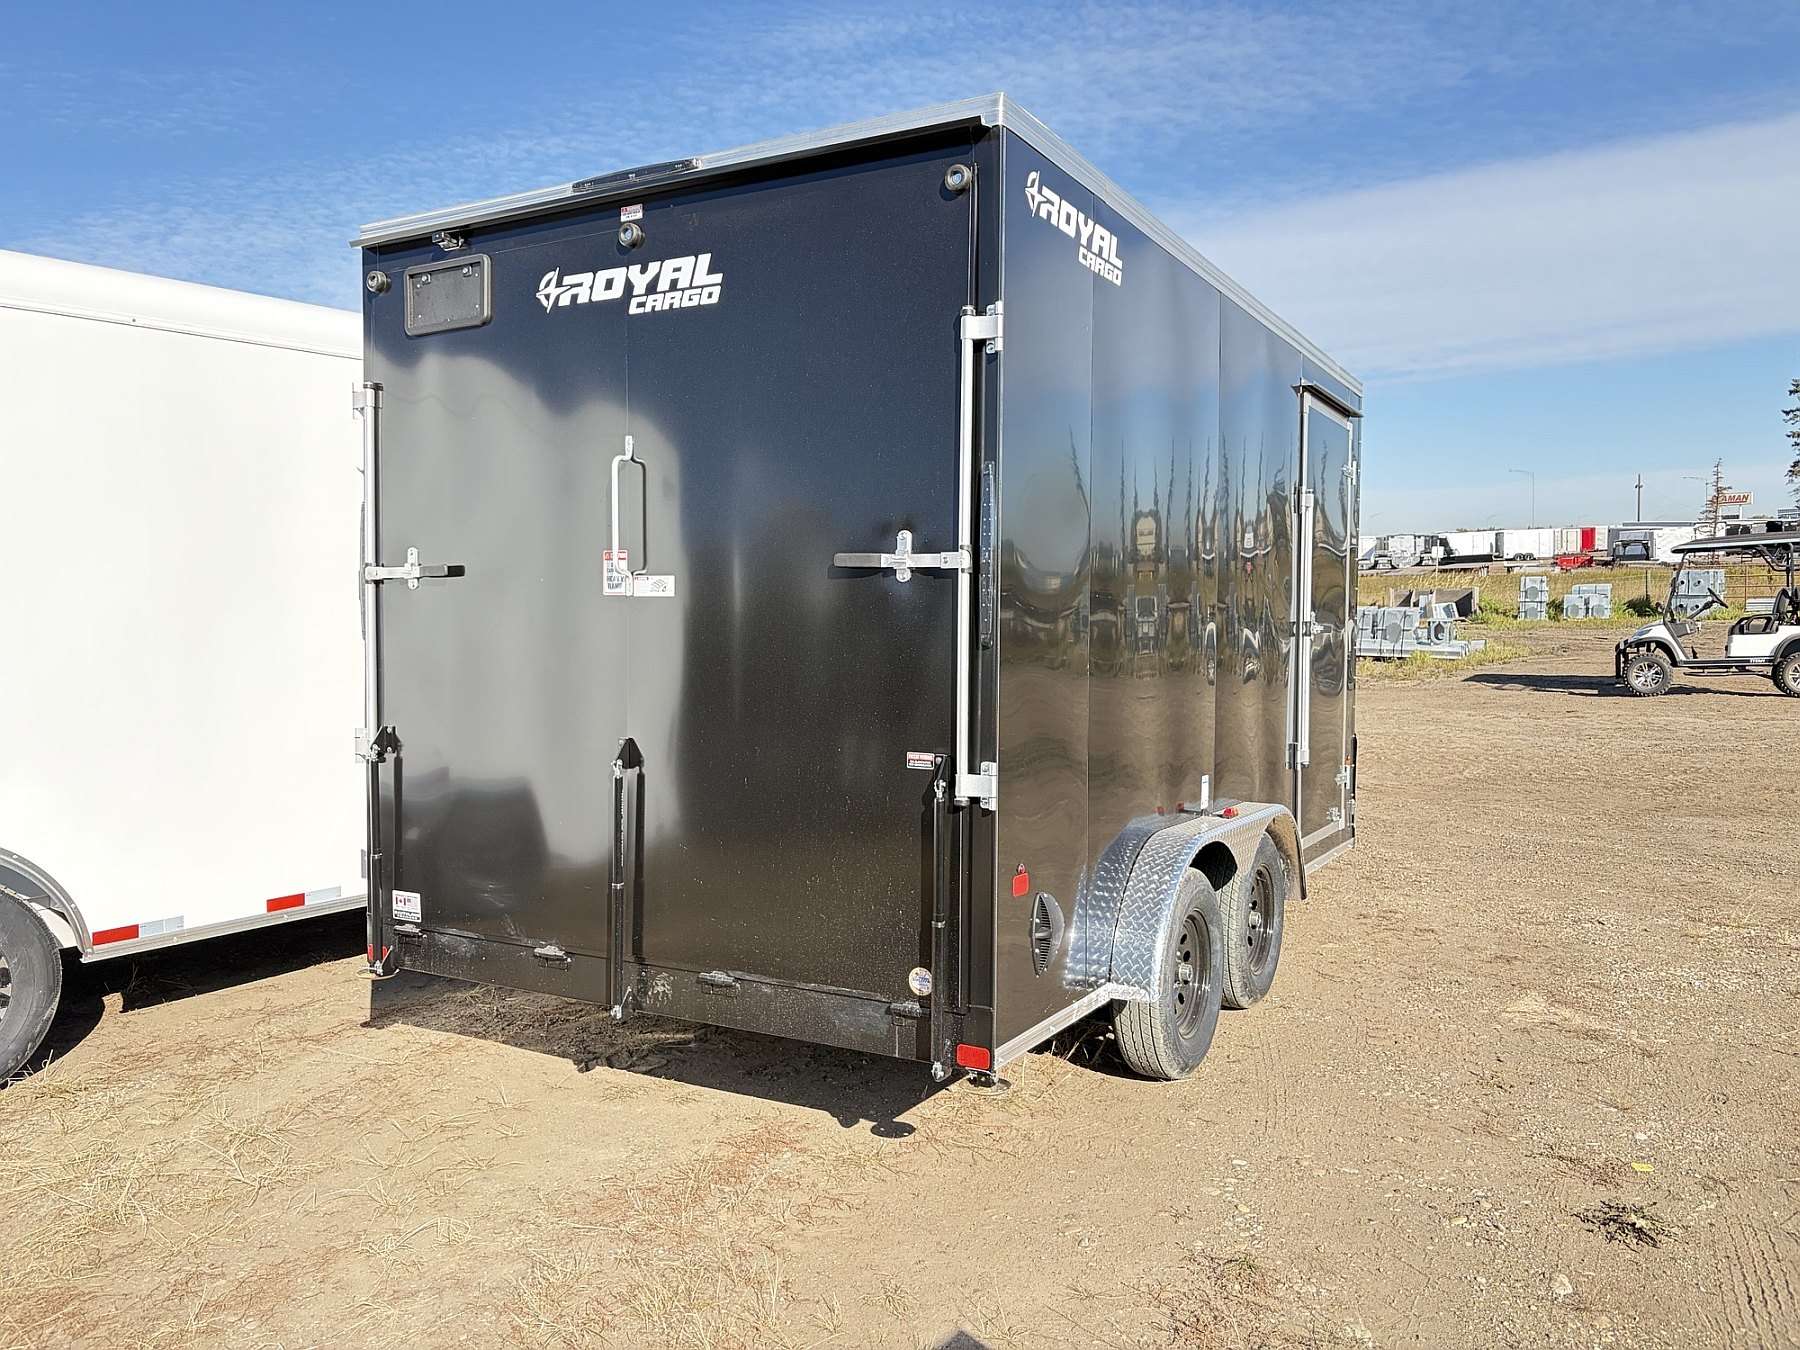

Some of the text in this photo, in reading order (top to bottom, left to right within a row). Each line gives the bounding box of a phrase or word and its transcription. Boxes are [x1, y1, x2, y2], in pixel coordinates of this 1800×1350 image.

[1039, 184, 1123, 270] ROYAL
[558, 252, 724, 307] ROYAL
[1078, 245, 1123, 287] CARGO
[628, 285, 722, 315] CARGO
